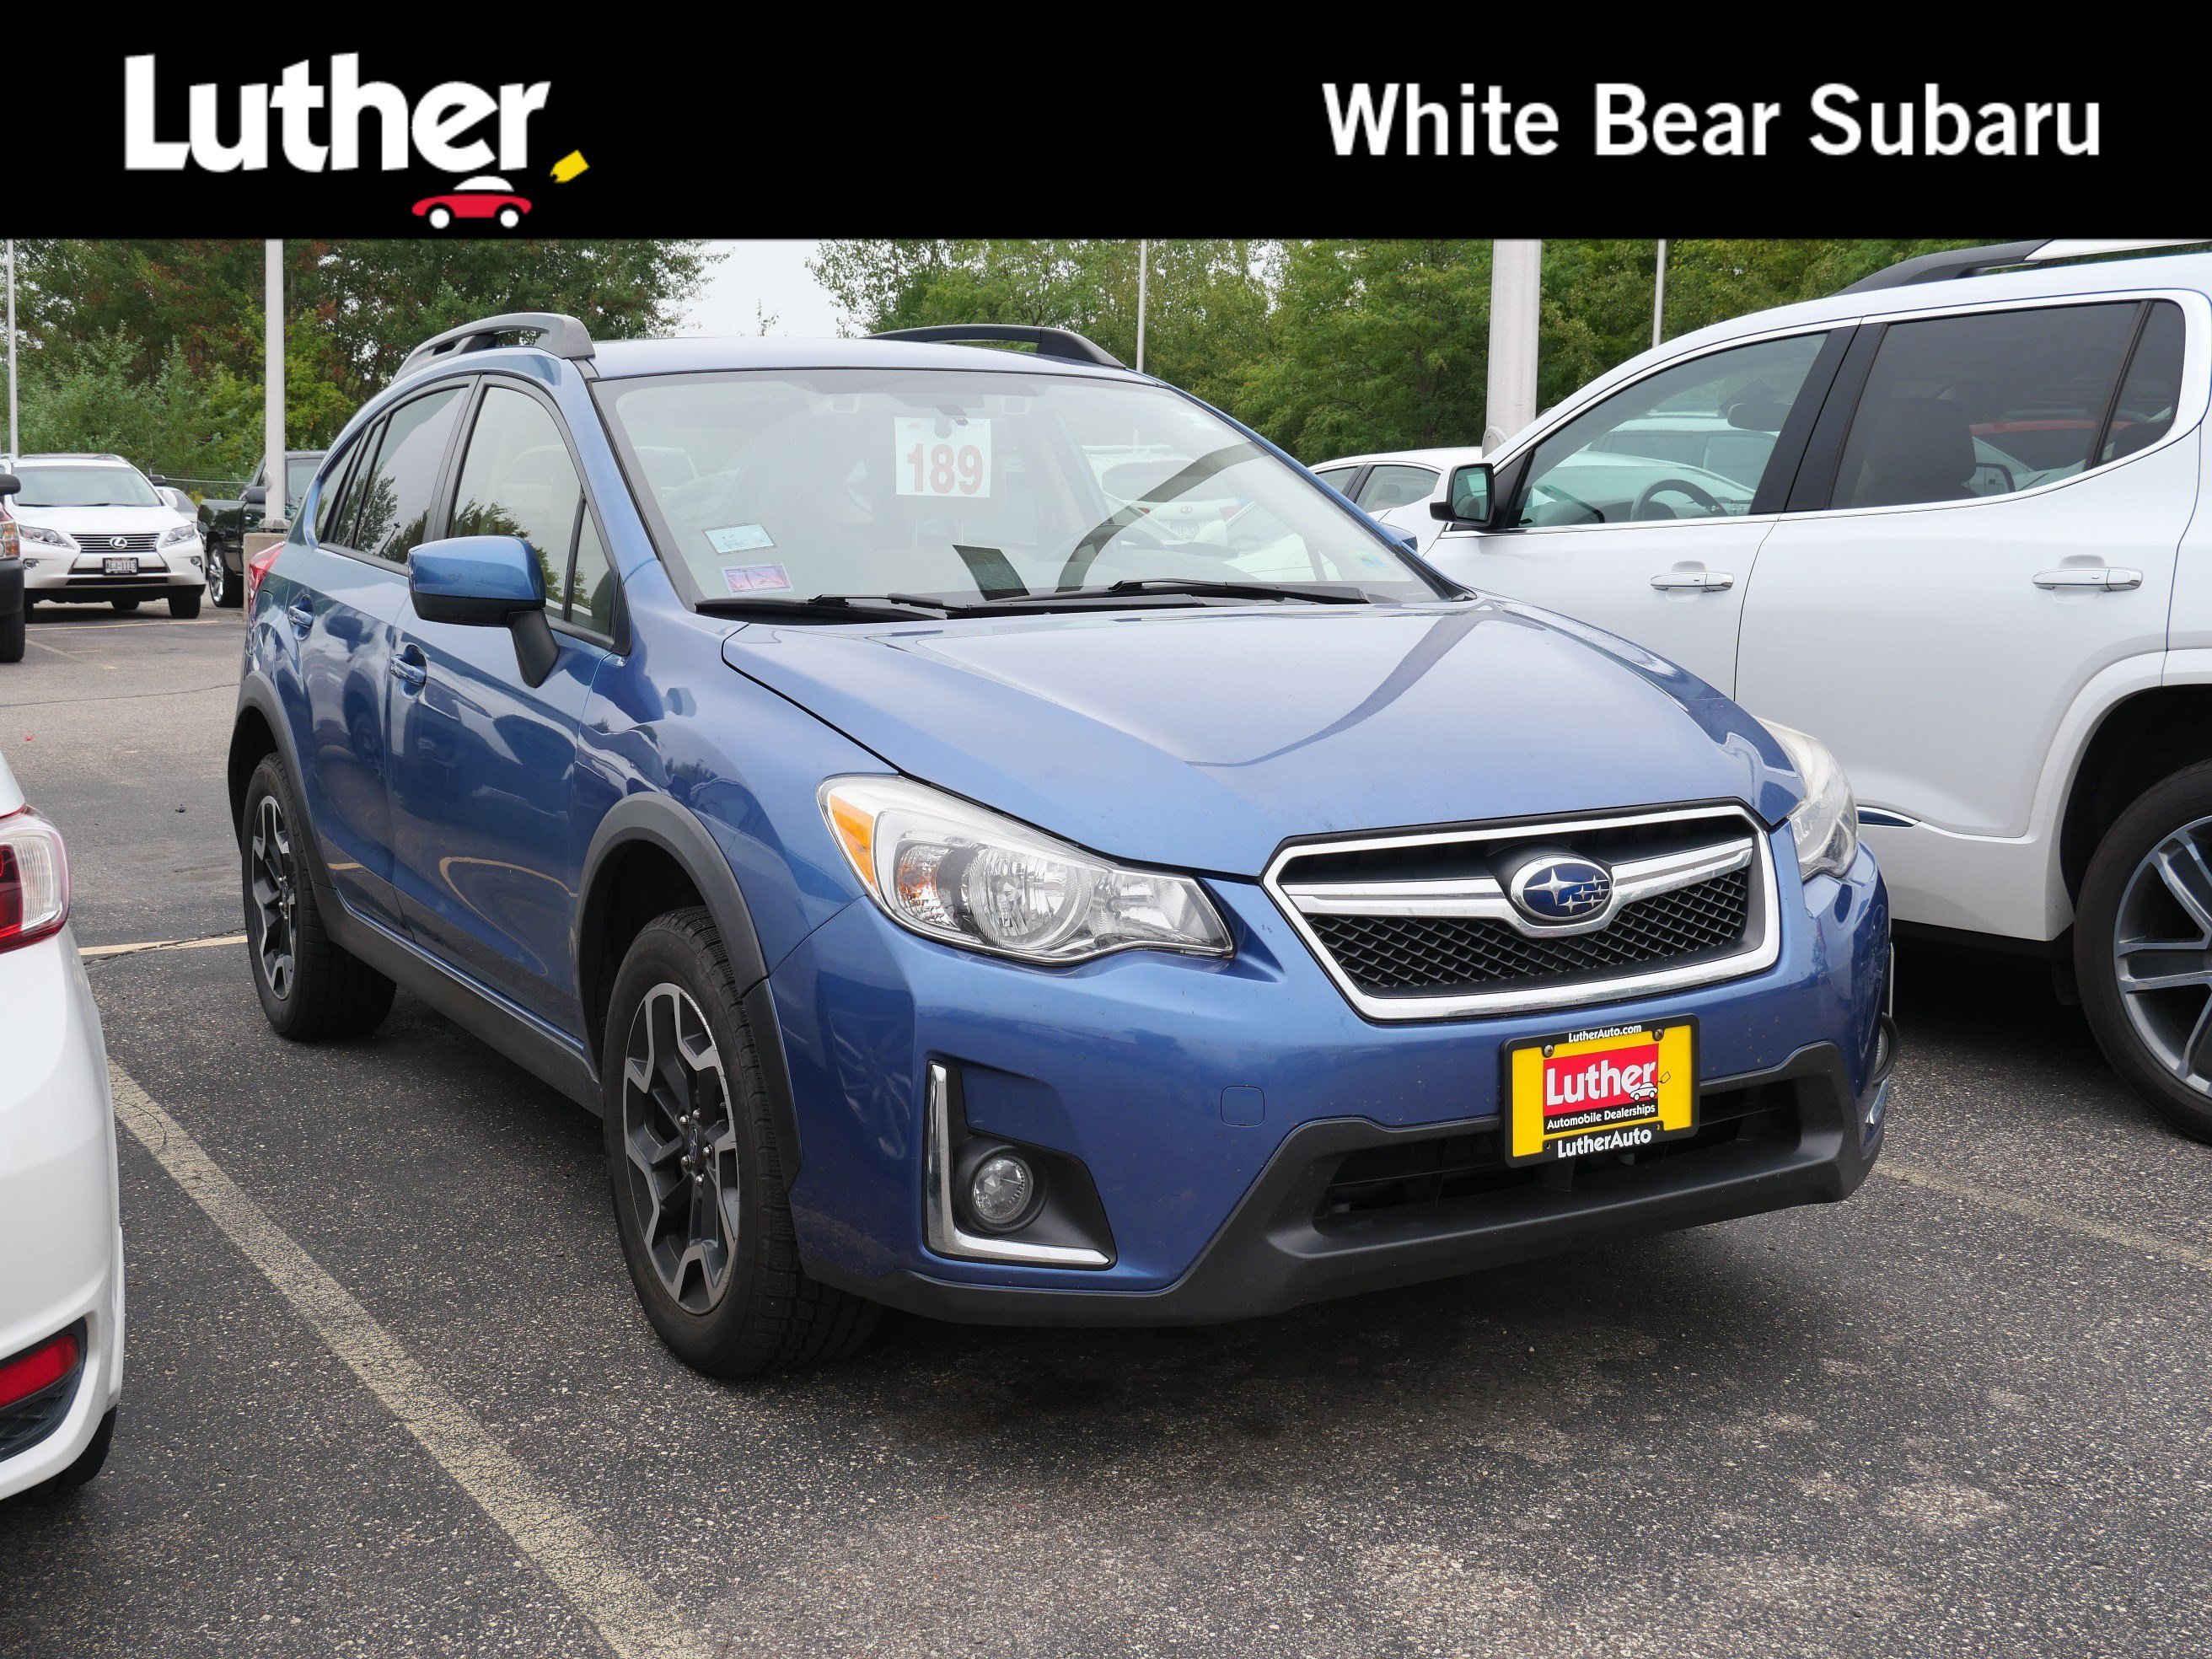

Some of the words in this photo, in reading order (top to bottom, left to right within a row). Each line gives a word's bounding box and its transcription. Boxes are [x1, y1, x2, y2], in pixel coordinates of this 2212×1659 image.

[908, 443, 983, 495] 189
[1568, 1024, 1642, 1043] LutherAuto.com
[1546, 1060, 1656, 1106] Luther
[1547, 1114, 1602, 1130] Automobile
[1603, 1103, 1656, 1121] Dealerships
[1558, 1128, 1652, 1158] LutherAuto
